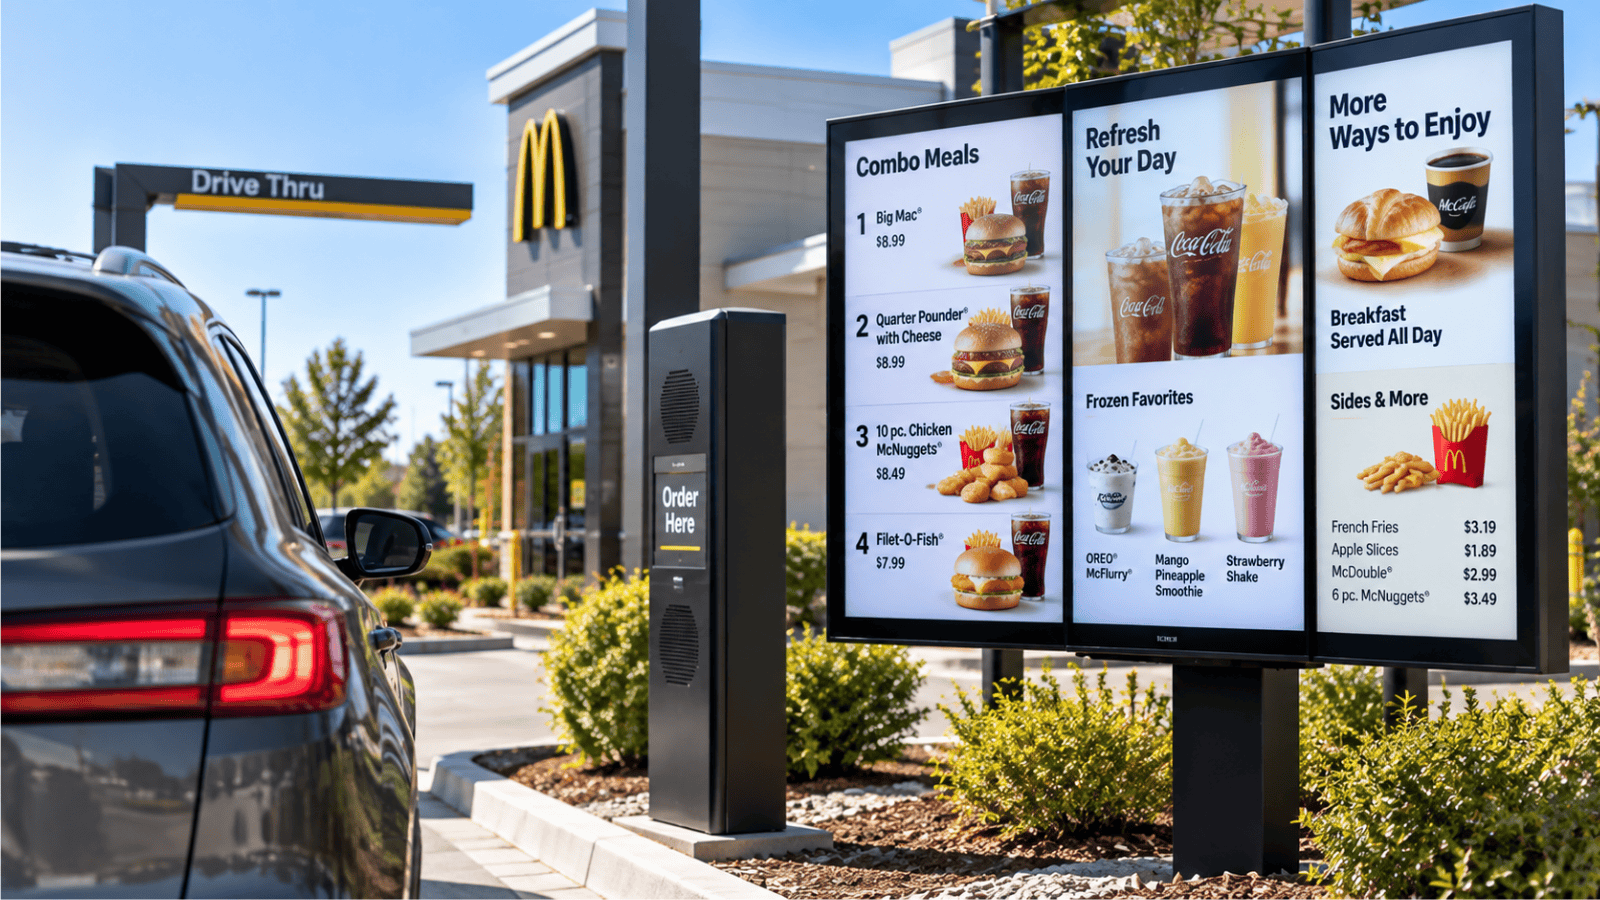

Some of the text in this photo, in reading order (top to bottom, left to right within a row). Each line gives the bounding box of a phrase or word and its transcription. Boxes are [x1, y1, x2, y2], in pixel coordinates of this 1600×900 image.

[1330, 93, 1387, 119] More
[1086, 118, 1160, 150] Refresh
[1329, 107, 1491, 152] Ways to Enjoy
[856, 143, 979, 177] Combo Meals
[1086, 149, 1177, 178] Your Day
[191, 169, 324, 199] Drive Thru
[857, 212, 865, 235] 1
[876, 210, 893, 226] Big
[876, 234, 905, 248] $8.99
[876, 312, 916, 328] Quarter
[1331, 305, 1406, 326] Breakfast
[856, 314, 869, 338] 2
[876, 329, 942, 345] with Cheese
[1331, 326, 1442, 349] Served All Day
[876, 355, 905, 369] $8.99
[1086, 389, 1193, 409] Frozen Favorites
[1331, 390, 1428, 410] Sides & More
[856, 425, 868, 448] 3
[876, 422, 952, 441] 10 pc. Chicken
[876, 467, 905, 480] $8.49
[662, 486, 699, 508] Order
[665, 512, 695, 534] Here
[1332, 520, 1399, 534] French Fries
[1464, 520, 1496, 534] $3.19
[856, 532, 869, 555] 4
[1331, 542, 1399, 558] Apple Slices
[1464, 544, 1496, 557] $1.89
[876, 556, 905, 569] $7.99
[1155, 554, 1189, 568] Mango
[1226, 554, 1285, 570] Strawberry
[1155, 569, 1205, 584] Pineapple
[1226, 570, 1258, 583] Shake
[1463, 567, 1497, 581] $2.99
[1155, 584, 1203, 597] Smoothie
[1332, 588, 1339, 601] 6
[1342, 591, 1358, 604] pc.
[1464, 591, 1497, 605] $3.49
